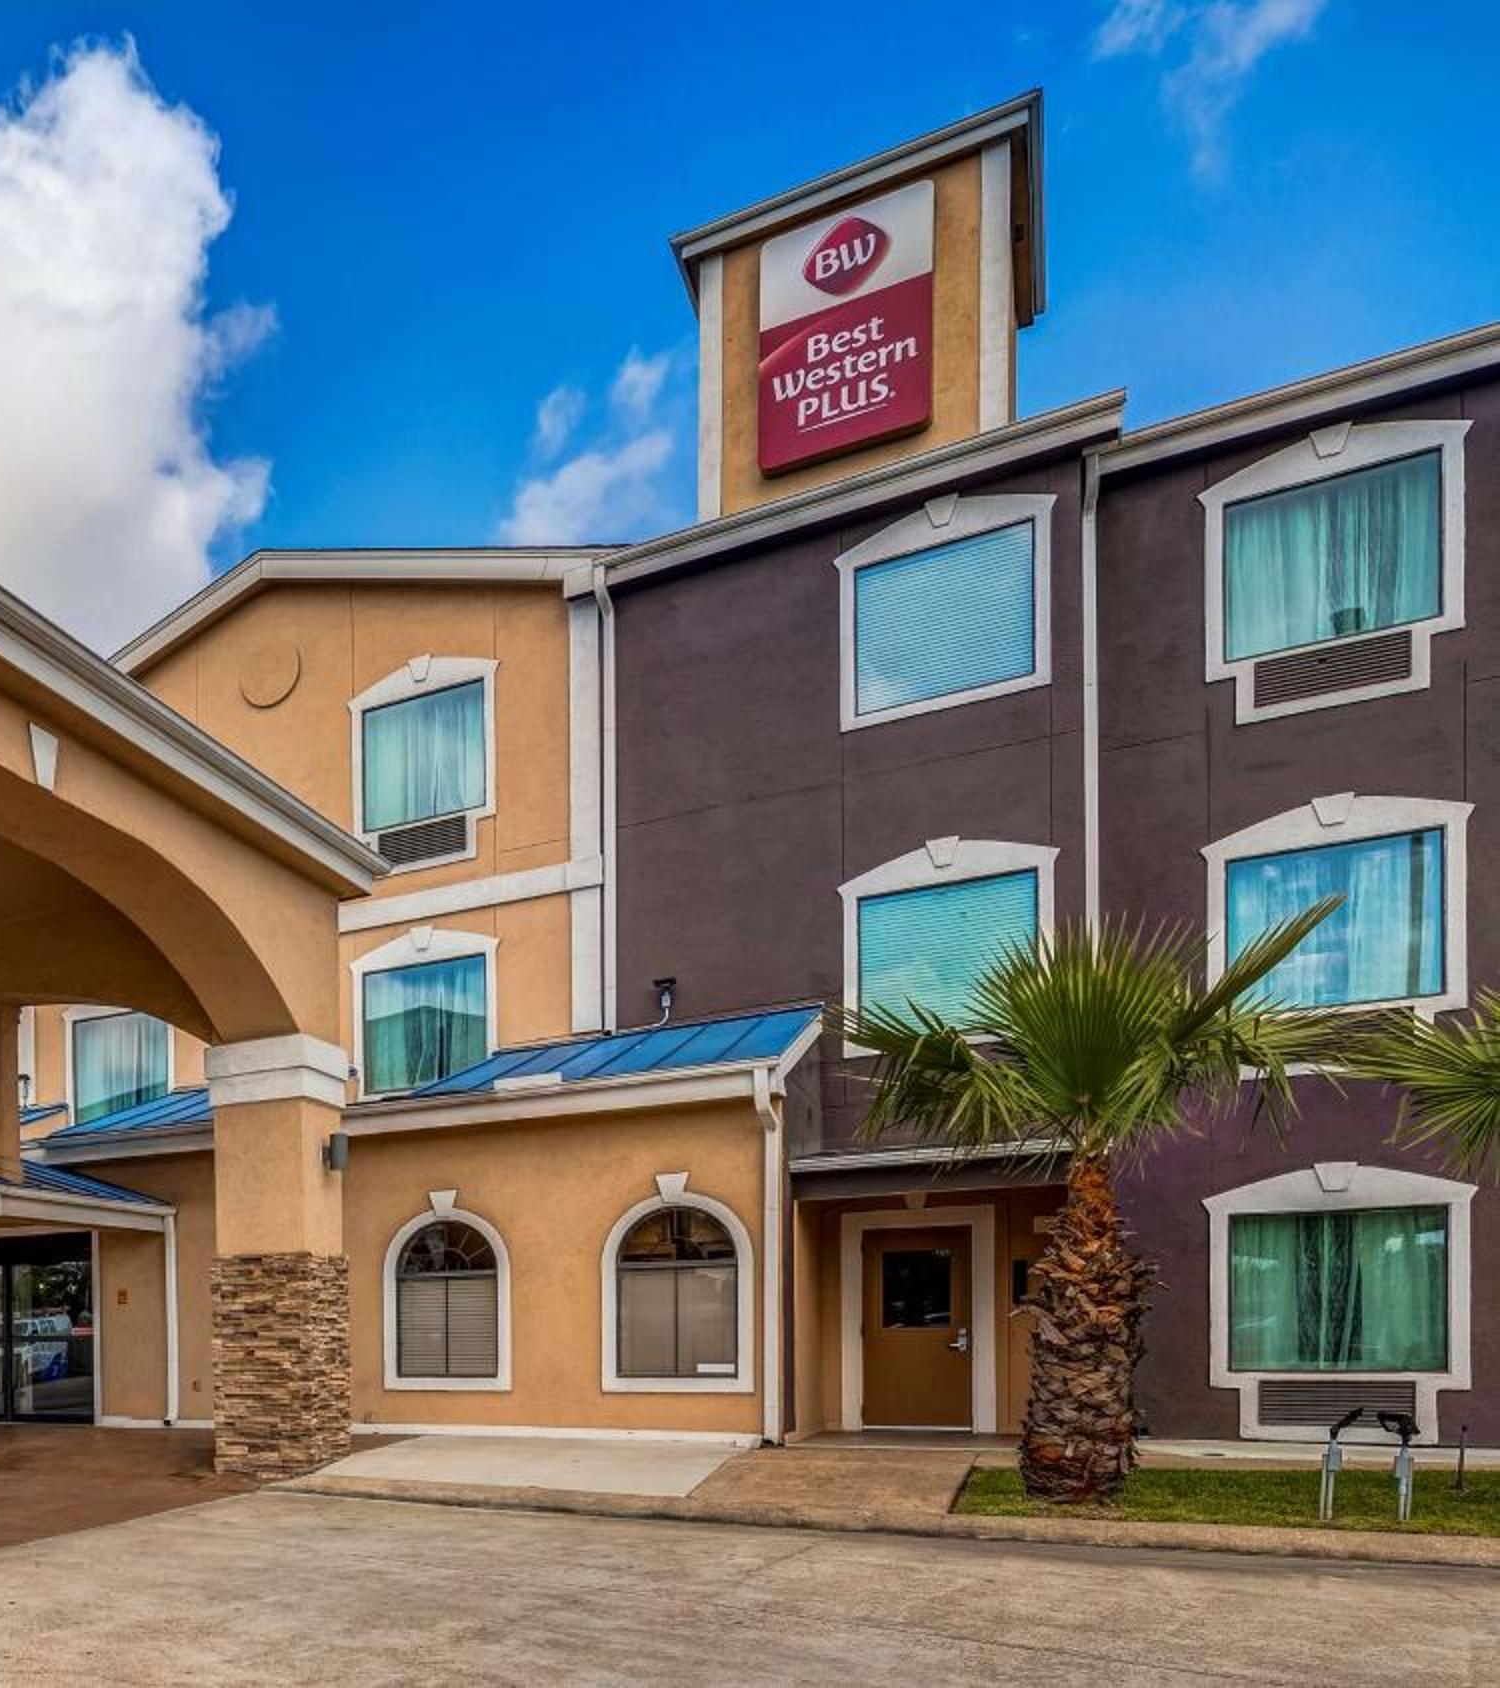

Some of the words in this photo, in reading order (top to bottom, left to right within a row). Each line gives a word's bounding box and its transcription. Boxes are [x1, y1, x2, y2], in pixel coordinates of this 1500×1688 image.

[814, 233, 876, 281] BW
[806, 315, 885, 364] Best
[771, 336, 919, 402] Western
